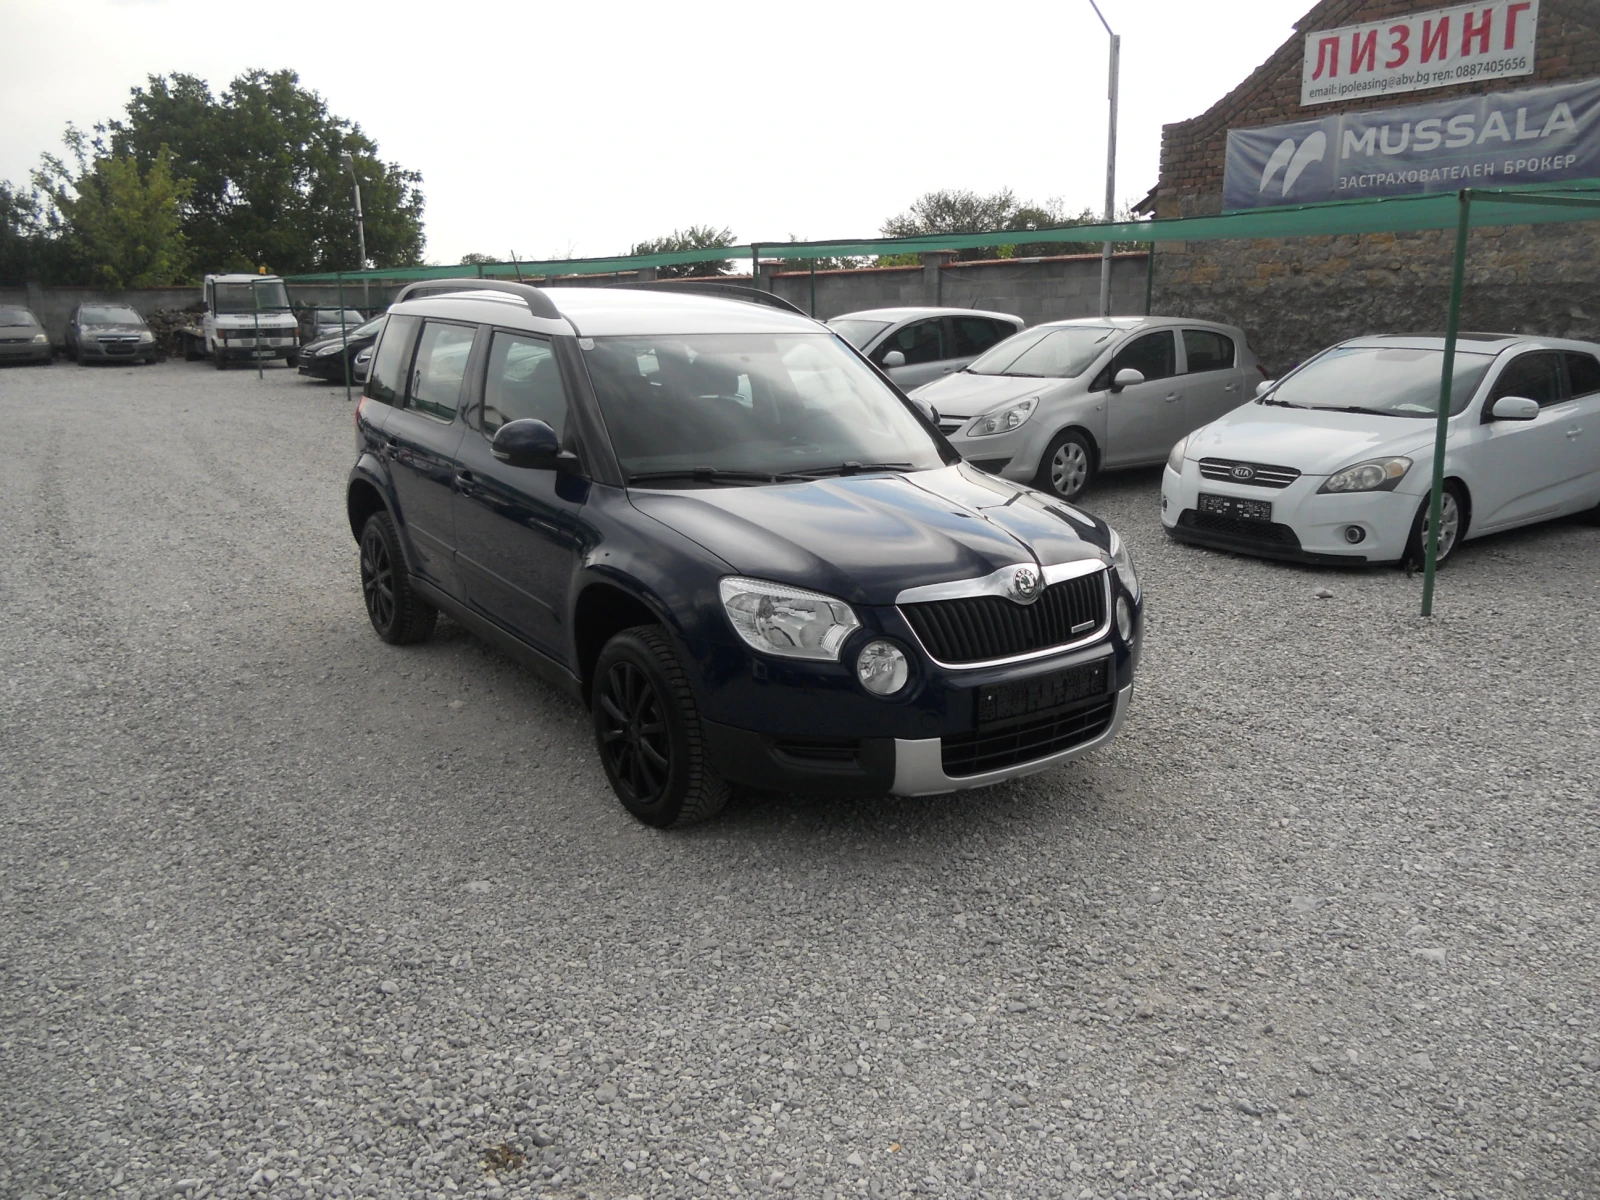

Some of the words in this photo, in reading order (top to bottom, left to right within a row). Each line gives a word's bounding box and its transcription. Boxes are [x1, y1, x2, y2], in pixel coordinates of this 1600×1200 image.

[1311, 2, 1531, 81] ЛИЗИНГ
[1309, 83, 1337, 98] email:
[1338, 70, 1430, 97] ipoleasing@abv.bg
[1432, 69, 1454, 81] тел:
[1456, 56, 1527, 78] 0887405656
[1341, 102, 1578, 160] MUSSALA
[1339, 162, 1495, 189] ЗАСТРАХОВАТЕЛЕН
[1503, 154, 1577, 175] БРОКЕР
[1234, 468, 1249, 477] KIA
